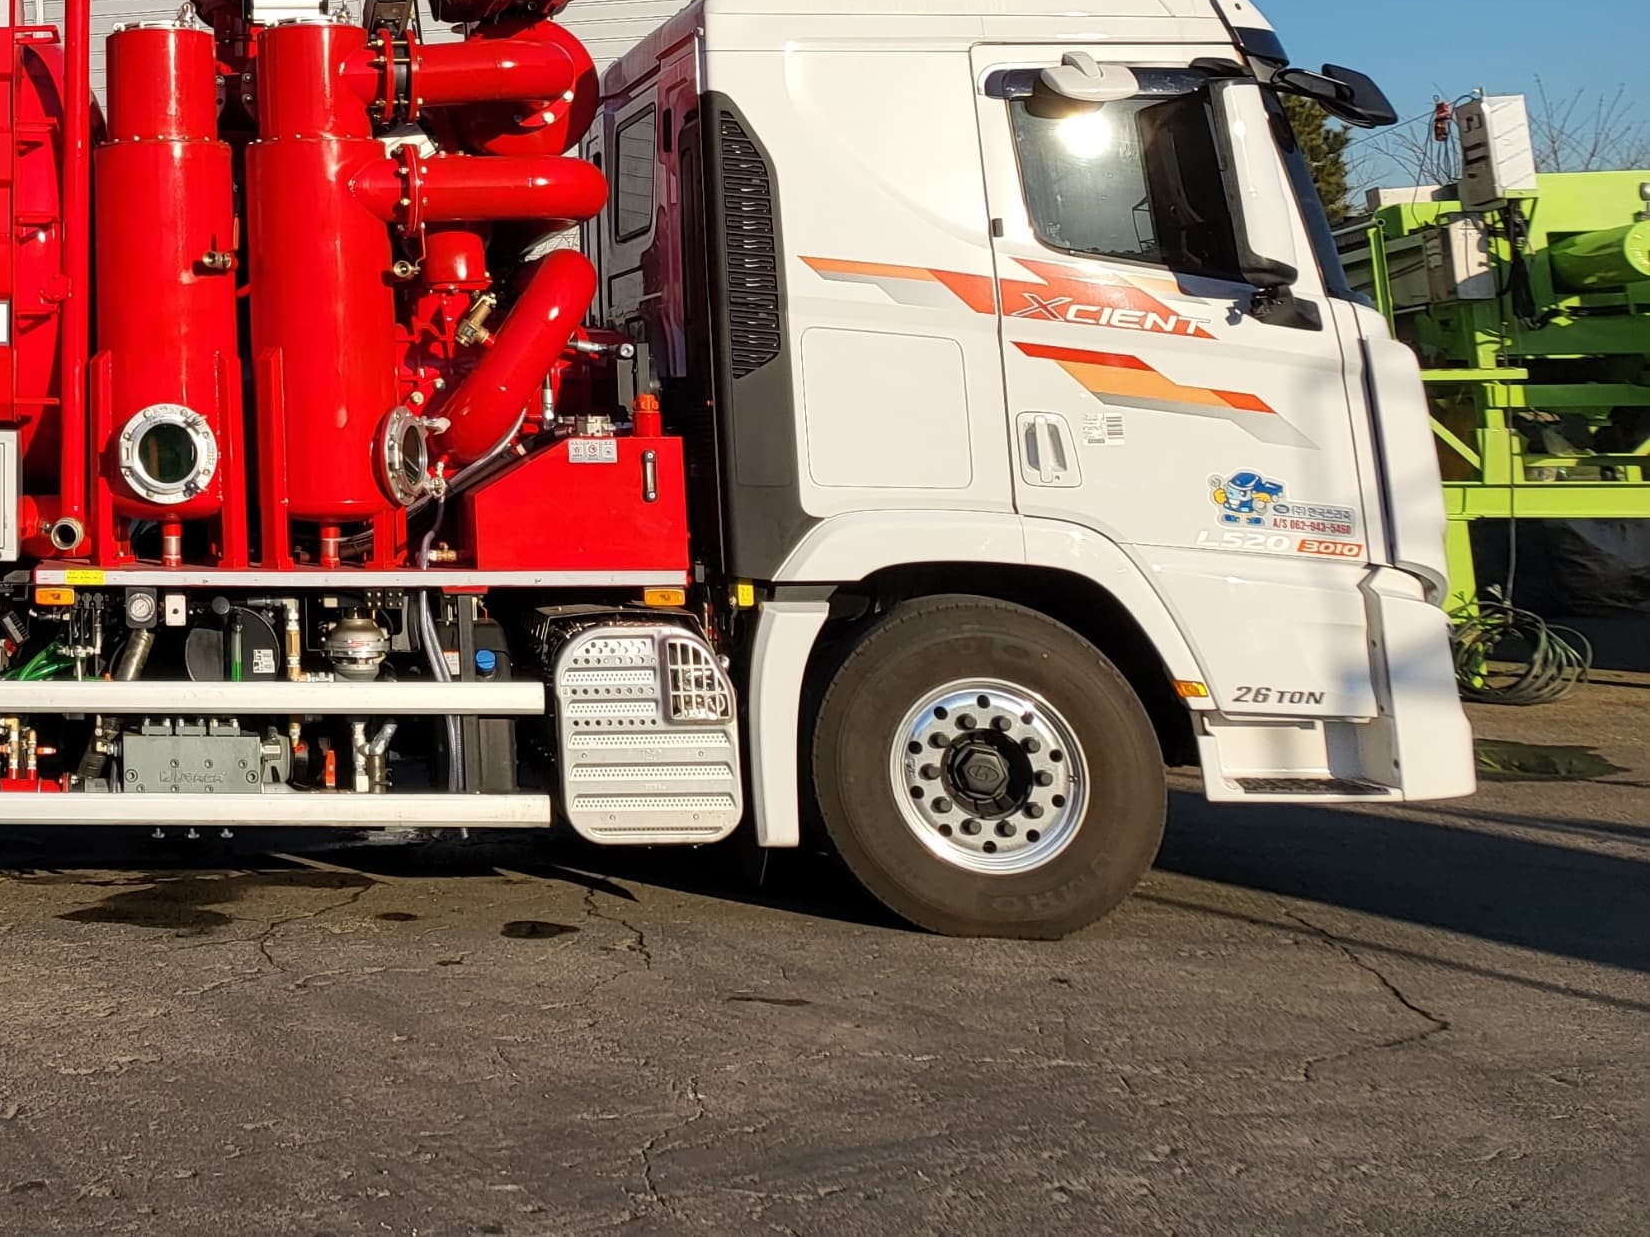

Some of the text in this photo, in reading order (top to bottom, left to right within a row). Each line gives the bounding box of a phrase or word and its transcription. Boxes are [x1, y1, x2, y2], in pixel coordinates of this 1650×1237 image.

[1012, 292, 1211, 334] XCIENT
[1272, 518, 1288, 529] A/S
[1196, 530, 1360, 556] L520 3010
[1231, 685, 1327, 706] 26 TON
